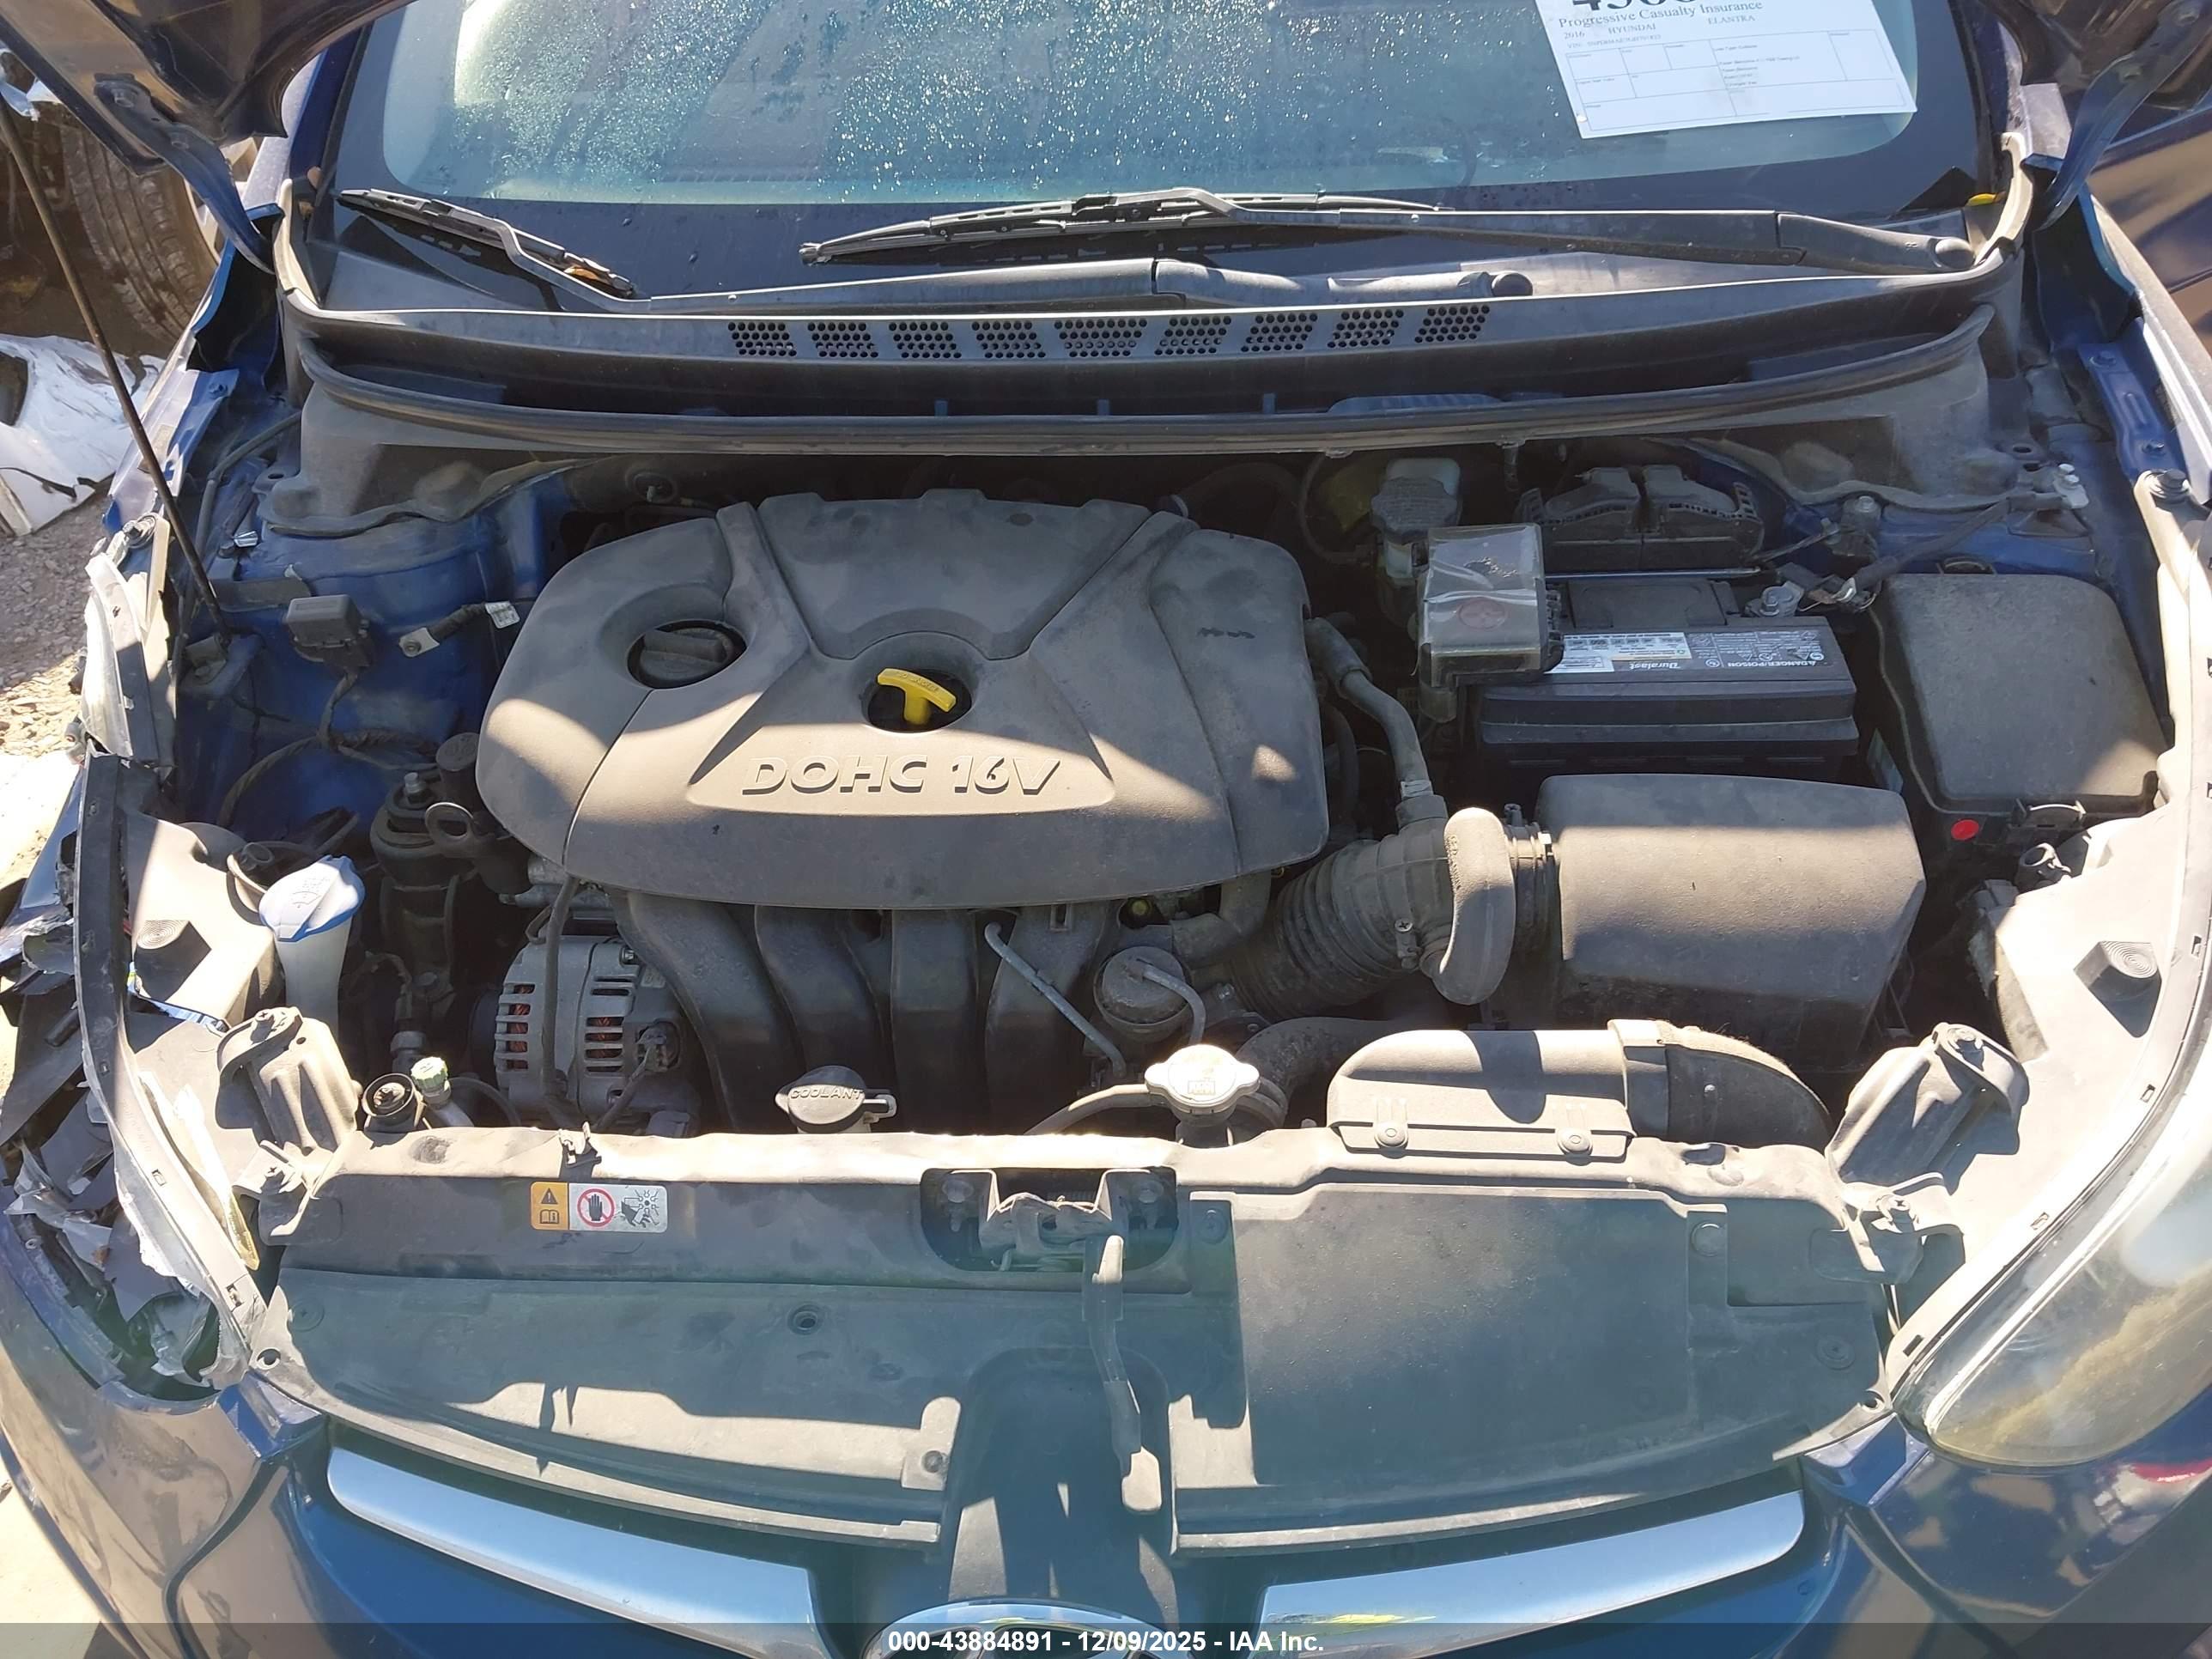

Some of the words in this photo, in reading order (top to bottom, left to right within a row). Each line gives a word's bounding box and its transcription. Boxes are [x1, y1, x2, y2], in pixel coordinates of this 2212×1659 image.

[1559, 11, 1636, 28] Progressive
[1638, 6, 1697, 19] Casualty
[1700, 2, 1763, 14] Insurance
[1564, 31, 1585, 40] 2016
[1607, 23, 1656, 34] HYUNDAI
[1707, 15, 1755, 25] ELANTRA
[1629, 661, 1680, 670] Duralast
[742, 755, 928, 796] DOHC
[951, 755, 1060, 796] 16V
[790, 1088, 864, 1100] COOLANT
